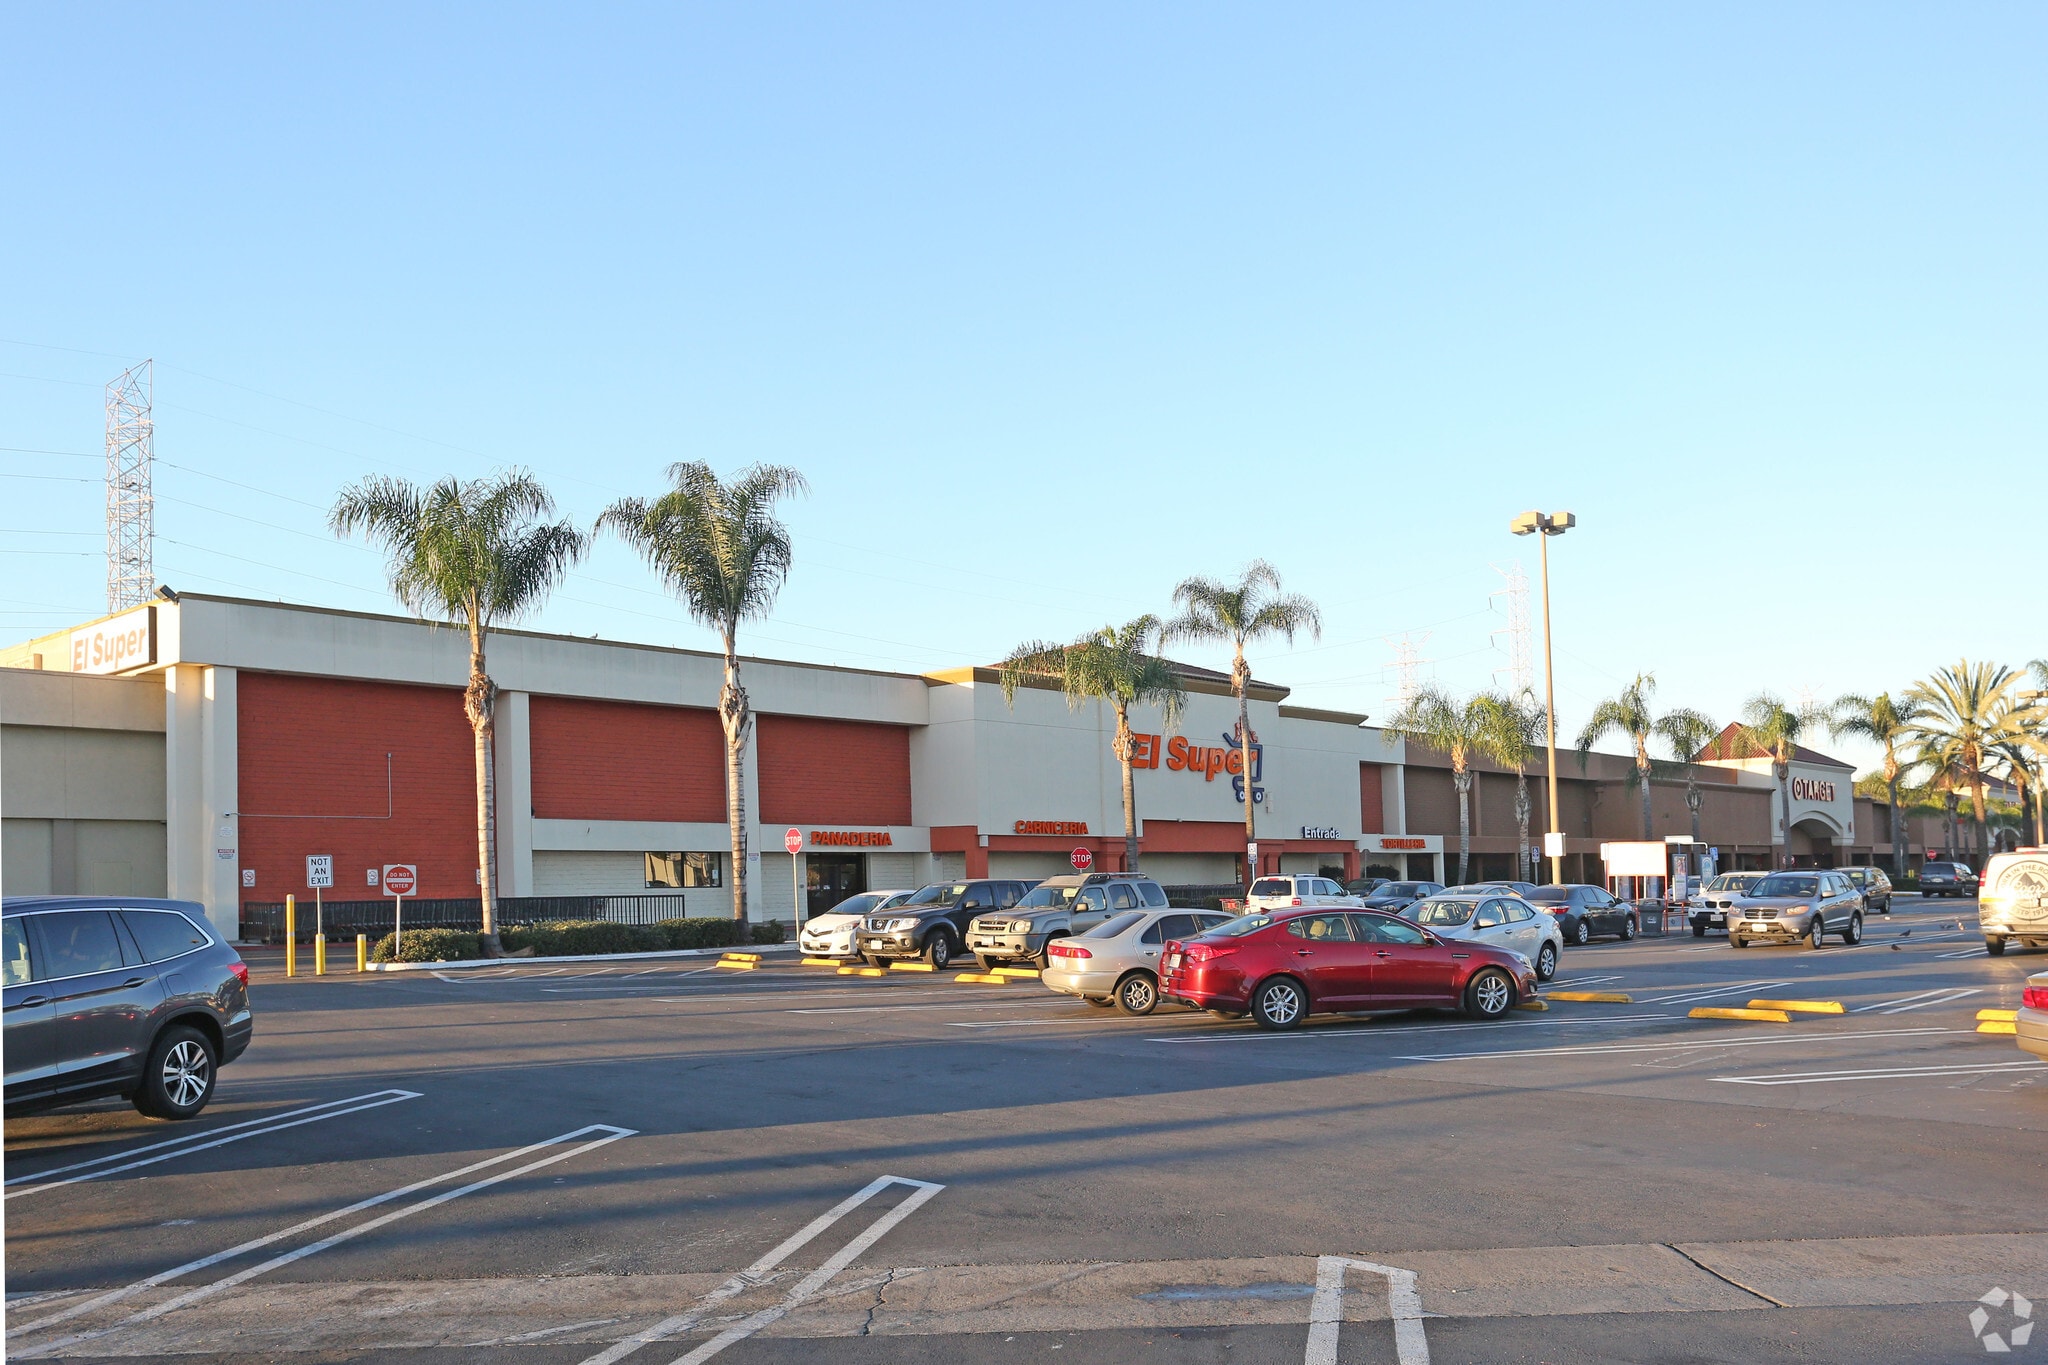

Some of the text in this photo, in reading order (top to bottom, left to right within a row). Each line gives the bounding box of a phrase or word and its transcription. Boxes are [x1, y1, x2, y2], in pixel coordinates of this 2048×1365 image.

[73, 627, 147, 671] El Super
[1131, 733, 1161, 768] El
[1802, 779, 1836, 802] TARGET
[1014, 820, 1089, 835] CARNICERIA
[1302, 826, 1341, 839] Entrada
[785, 836, 801, 846] STOP
[810, 831, 893, 846] PANADERIA
[1381, 838, 1427, 849] TORTILLERIA
[1071, 854, 1091, 863] STOP
